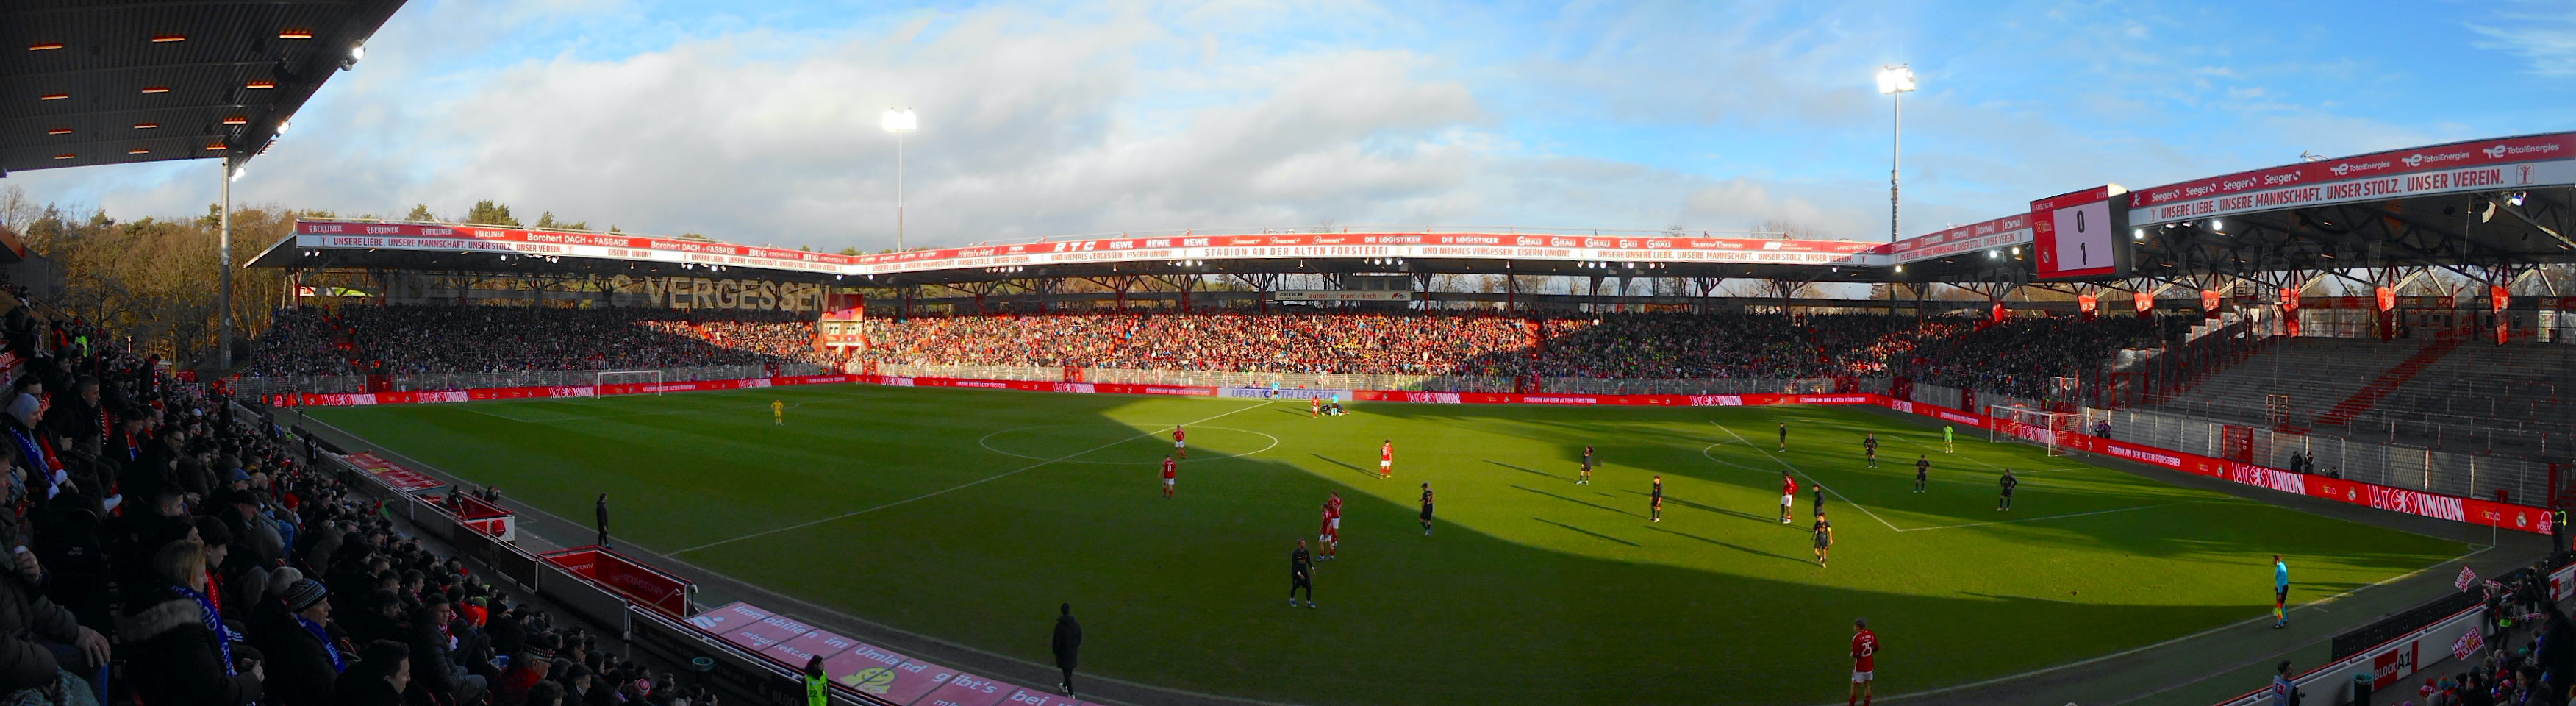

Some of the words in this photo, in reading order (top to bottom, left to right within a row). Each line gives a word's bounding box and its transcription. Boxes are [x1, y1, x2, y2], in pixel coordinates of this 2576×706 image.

[2507, 143, 2560, 156] TotalEnergies
[2423, 151, 2470, 164] TotalEnergies
[2349, 161, 2390, 173] TotalEnergies
[2223, 179, 2249, 191] Seeger
[2264, 173, 2292, 185] Seeger
[2161, 205, 2190, 219] UNSERE
[2192, 202, 2216, 215] LIEBE.
[2219, 196, 2253, 212] UNSERE
[2255, 187, 2323, 208] MANNSCHAFT.
[2327, 183, 2361, 200] UNSER
[2364, 178, 2402, 196] STOLZ.
[2407, 174, 2448, 192] UNSER
[2453, 168, 2505, 188] VEREIN.
[2186, 185, 2210, 197] Seeger
[2151, 192, 2174, 203] Seeger
[2076, 210, 2085, 234] 0
[312, 224, 343, 235] BERLINER
[370, 225, 399, 236] BERLINER
[478, 230, 505, 239] BERLINER
[334, 237, 362, 246] UNSERE
[363, 238, 385, 247] LIEBE.
[388, 238, 415, 247] UNSERE
[418, 240, 466, 249] MANNSCHAFT.
[468, 241, 490, 250] UNSER
[492, 242, 513, 251] STOLZ.
[516, 243, 537, 252] UNSER
[538, 244, 562, 253] VEREIN.
[527, 232, 562, 243] Borchert
[564, 235, 586, 244] DACH
[594, 237, 629, 248] FASSADE
[1109, 240, 1133, 249] REWE
[1145, 239, 1170, 248] REWE
[1184, 238, 1209, 247] REWE
[1983, 237, 1998, 246] UNSER
[1999, 232, 2017, 244] VEREIN.
[608, 249, 628, 257] EISERN
[632, 249, 651, 257] UNION!
[651, 240, 681, 252] Borchert
[681, 243, 701, 252] DACH
[706, 245, 736, 254] FASSADE
[1205, 248, 1247, 257] STADION
[1253, 248, 1265, 256] AN
[1270, 247, 1289, 256] DER
[1294, 246, 1326, 255] ALTEN
[1423, 247, 1437, 255] UND
[1439, 247, 1470, 256] NIEMALS
[1472, 247, 1514, 256] VERGESSEN:
[1517, 248, 1542, 256] EISERN
[1545, 249, 1569, 257] UNION!
[749, 249, 767, 258] BUG
[803, 253, 819, 262] BUG
[1064, 253, 1088, 261] NIEMALS
[1090, 252, 1124, 260] VERGESSEN:
[1149, 249, 1171, 257] UNION!
[1677, 252, 1704, 260] UNSERE
[1706, 252, 1753, 260] MANNSCHAFT.
[1830, 255, 1853, 263] VEREIN.
[2080, 242, 2087, 265] 1
[691, 254, 709, 262] UNSERE
[710, 255, 726, 263] LIEBE.
[729, 257, 747, 265] UNSERE
[747, 258, 779, 267] MANNSCHAFT.
[779, 259, 793, 268] UNSER
[809, 262, 822, 270] UNSER
[822, 263, 837, 271] VEREIN.
[873, 264, 888, 272] UNSERE
[905, 262, 922, 270] UNSERE
[923, 260, 956, 268] MANNSCHAFT.
[992, 256, 1010, 264] UNSER
[1011, 255, 1031, 263] VEREIN.
[645, 276, 831, 312] VERGESSEN
[1231, 389, 1256, 398] UEFA
[1258, 390, 1292, 399] YOTH
[2107, 445, 2125, 456] STADION
[2125, 447, 2132, 457] AN
[2132, 449, 2141, 458] DER
[2141, 451, 2155, 461] ALTEN
[2269, 469, 2306, 496] UNION
[2417, 492, 2466, 523] UNION
[2536, 523, 2552, 531] YOUT
[734, 605, 818, 638] Immobilien
[824, 635, 848, 649] im
[854, 645, 928, 674] Umland
[1861, 641, 1872, 657] 25
[2374, 661, 2397, 680] BLOCK
[2397, 650, 2412, 671] A1
[807, 689, 819, 698] 22
